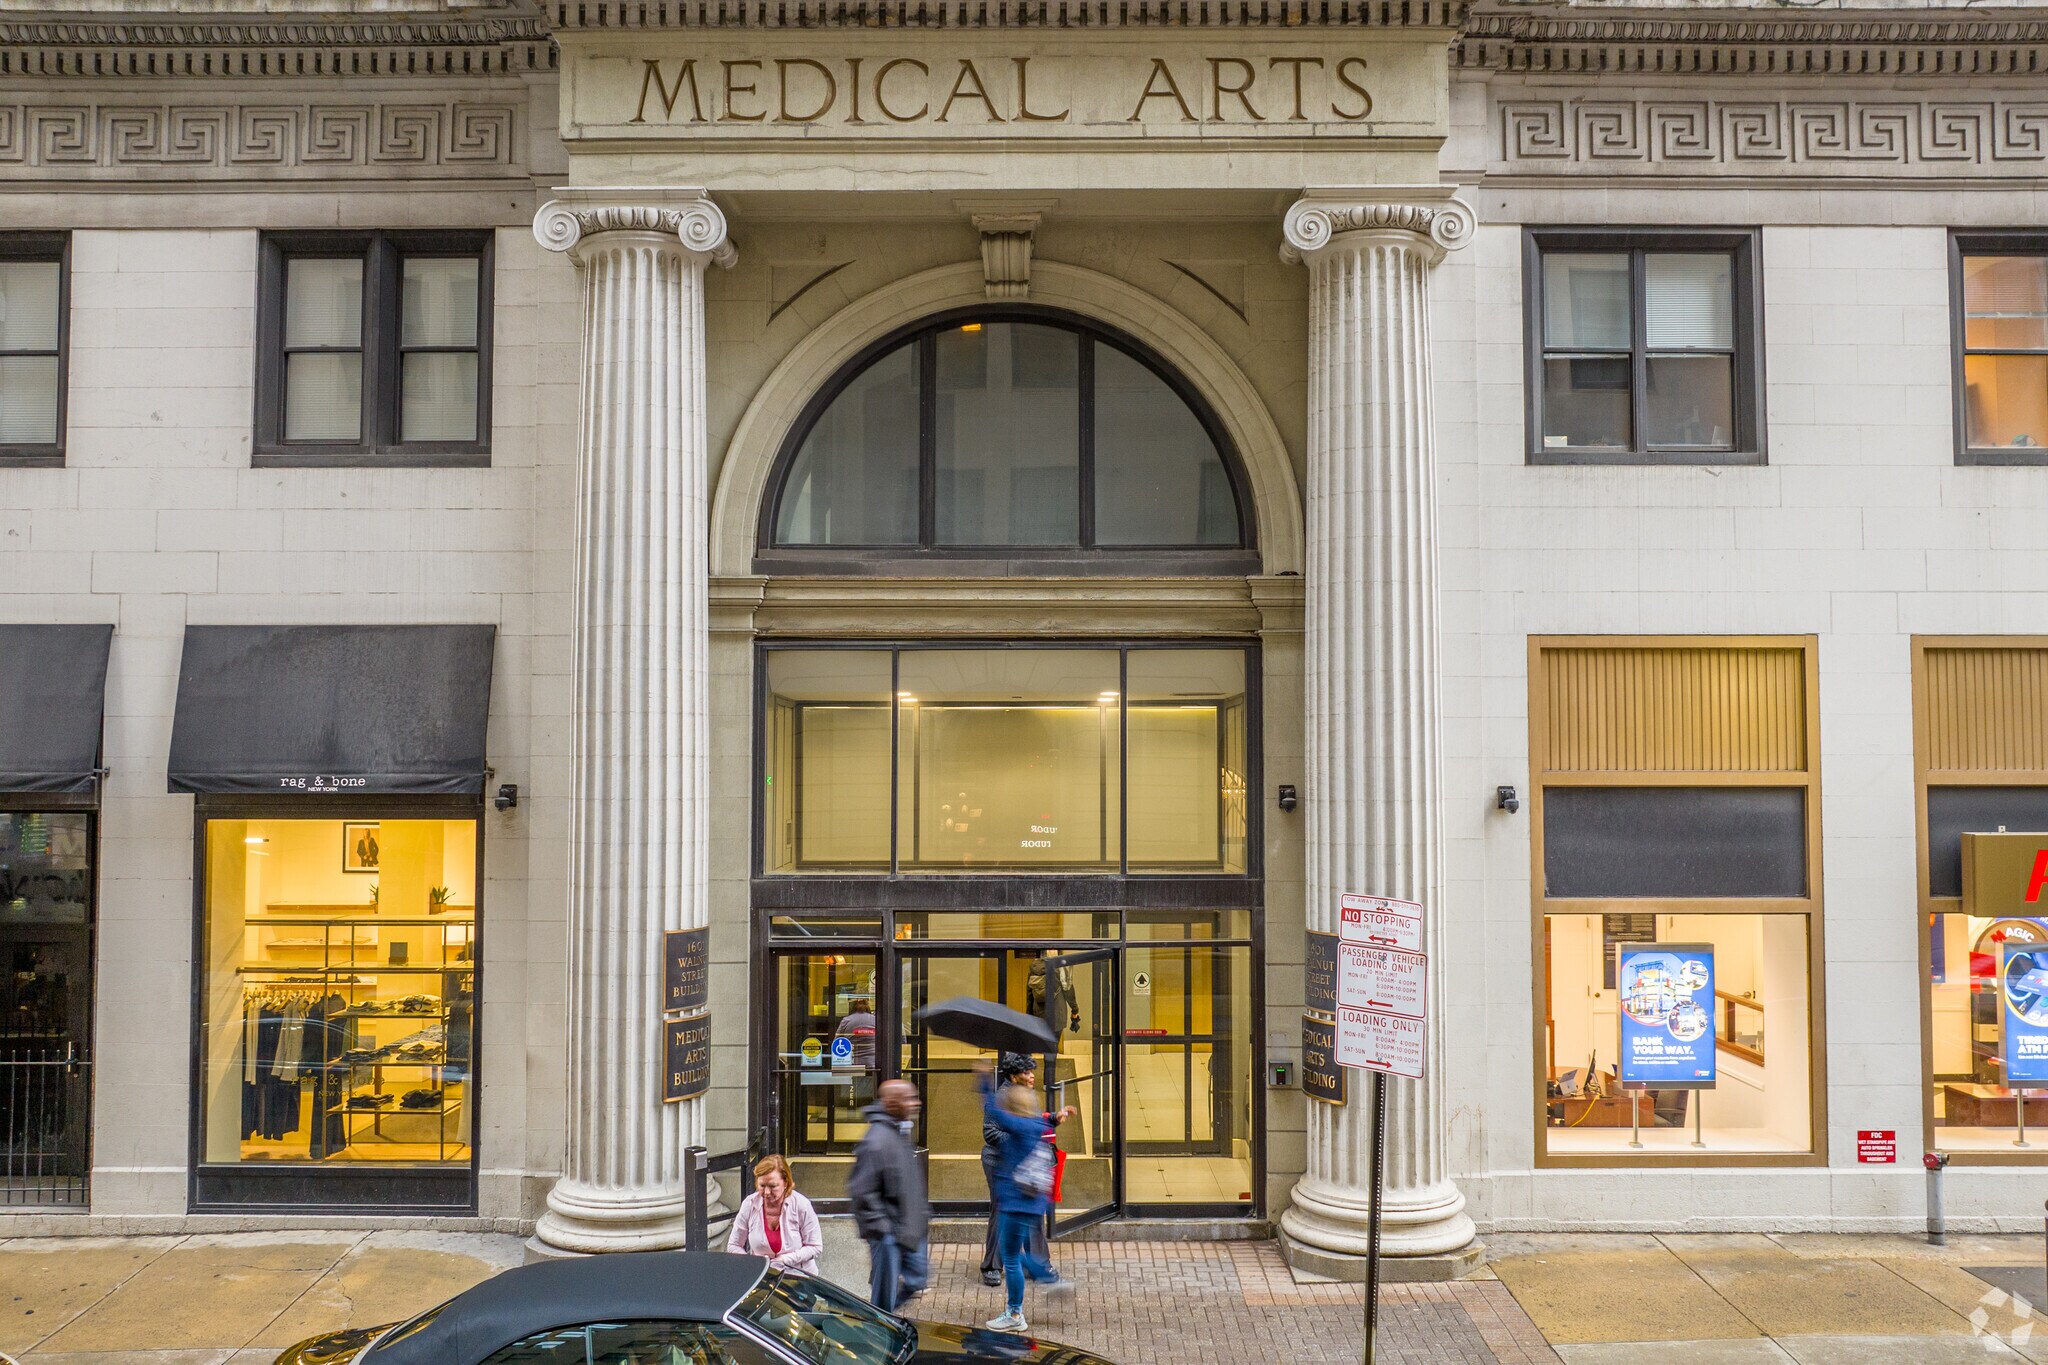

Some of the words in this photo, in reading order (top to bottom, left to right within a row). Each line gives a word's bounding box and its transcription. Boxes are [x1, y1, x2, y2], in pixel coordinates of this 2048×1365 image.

[629, 57, 1071, 123] MEDICAL
[1126, 57, 1374, 123] ARTS
[281, 777, 306, 788] rag
[314, 776, 324, 787] &
[332, 776, 366, 787] bone
[1344, 910, 1359, 921] NO
[1363, 912, 1411, 929] STOPPING
[1990, 927, 2035, 943] MAGIC
[1342, 946, 1388, 960] PASSENGER
[1392, 953, 1424, 967] VEHICLE
[1352, 957, 1388, 971] LOADING
[1391, 963, 1413, 974] ONLY
[1346, 987, 1367, 995] SAT-SUN
[1343, 1011, 1387, 1028] LOADING
[1392, 1019, 1419, 1033] ONLY
[1344, 1031, 1366, 1039] MON-FRI
[1384, 1029, 1398, 1037] LIMIT
[1632, 1036, 1664, 1045] BANK
[1344, 1046, 1366, 1055] SAT-SUN
[1632, 1045, 1664, 1055] YOUR
[1664, 1045, 1694, 1055] WAY.
[328, 1074, 338, 1085] &
